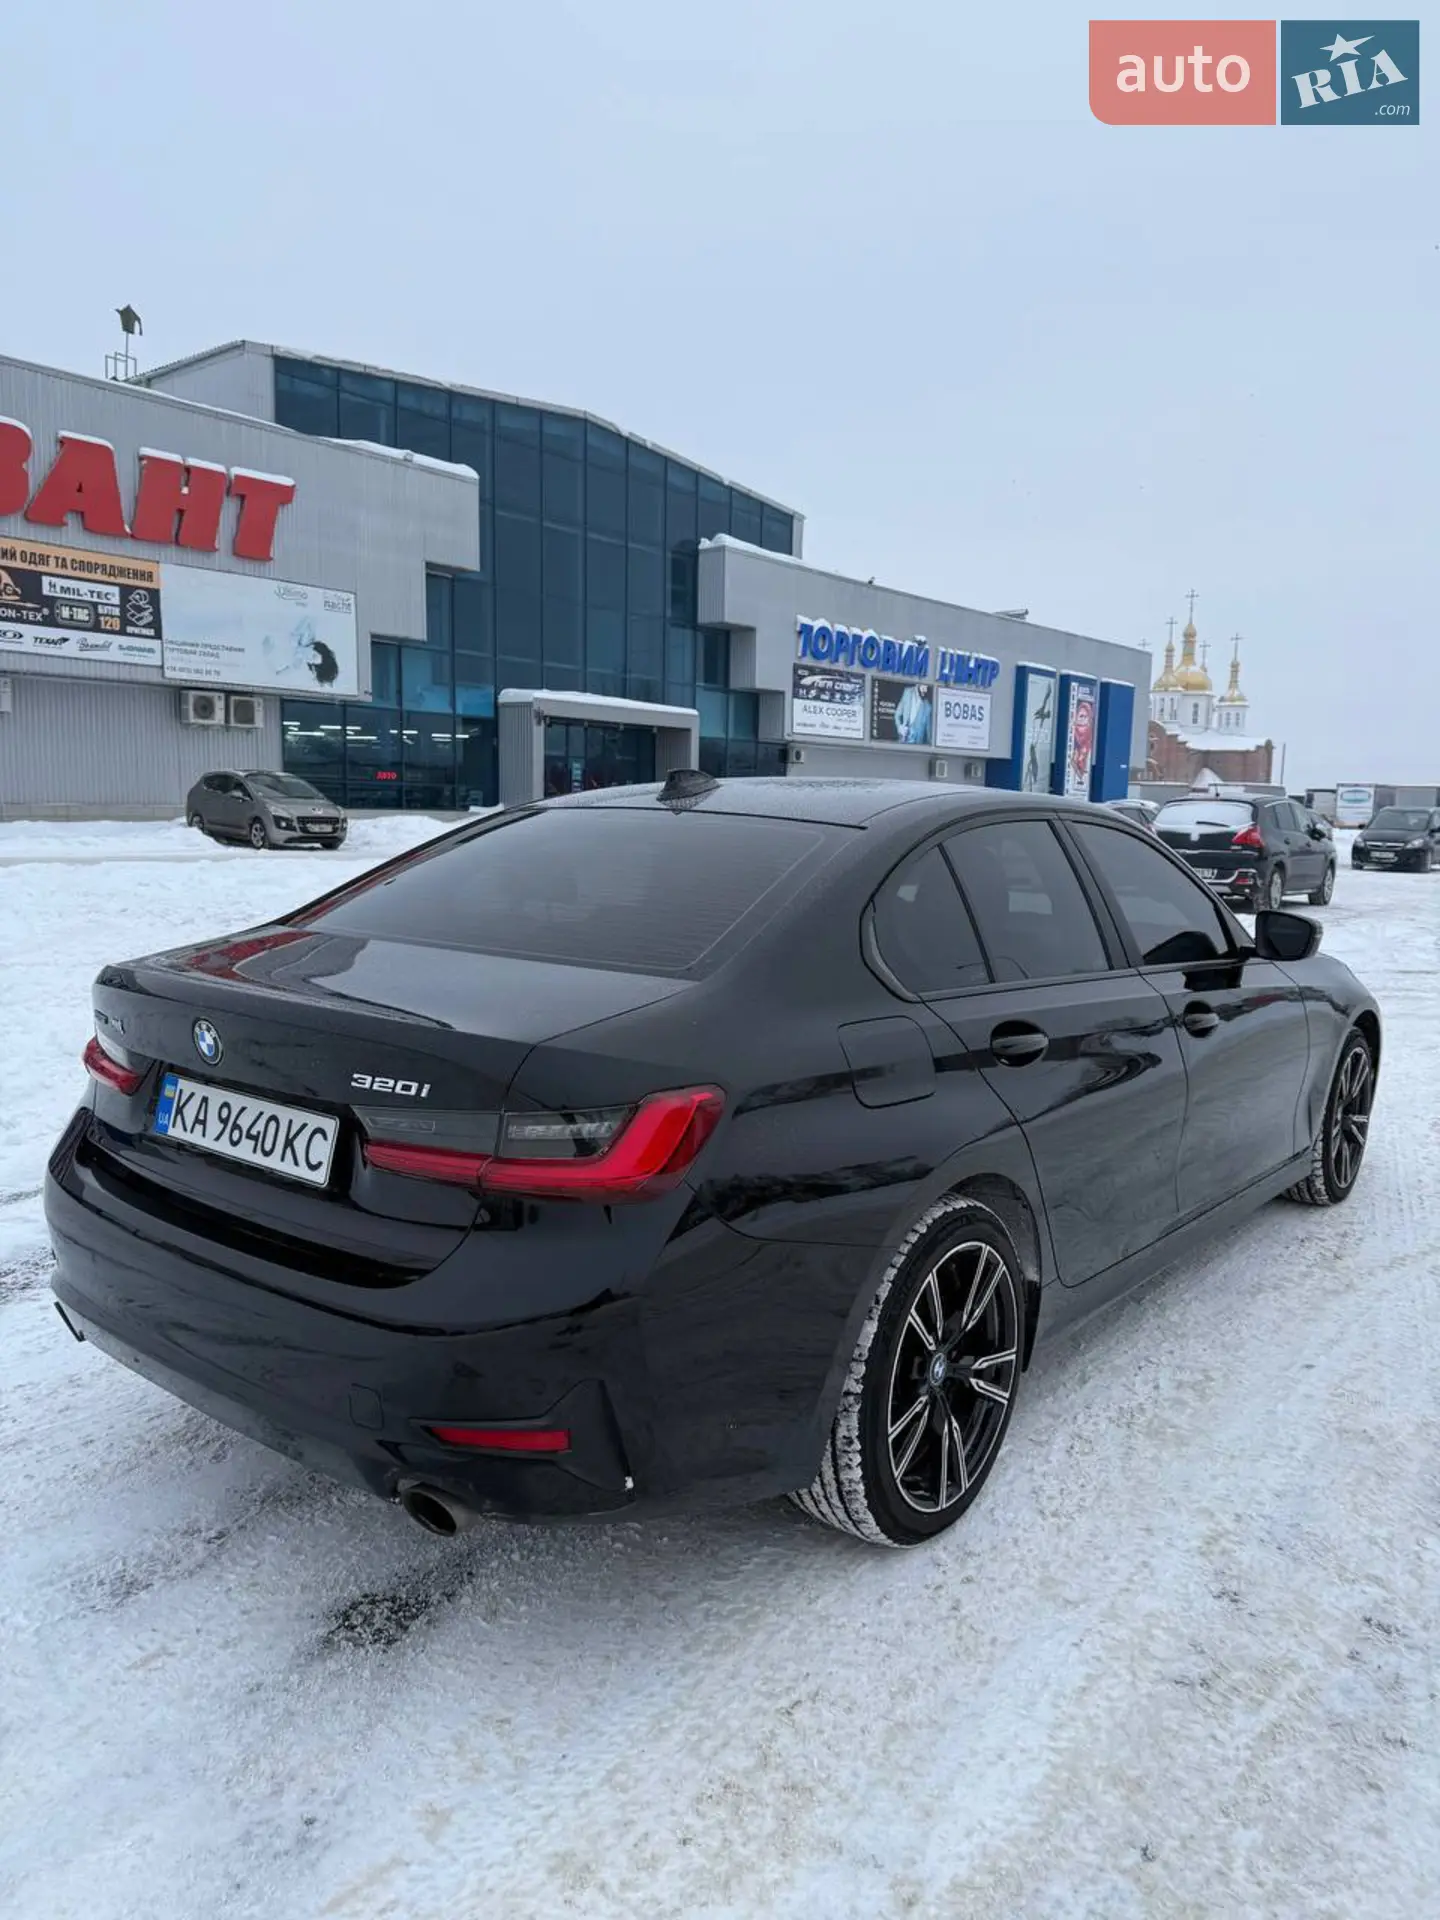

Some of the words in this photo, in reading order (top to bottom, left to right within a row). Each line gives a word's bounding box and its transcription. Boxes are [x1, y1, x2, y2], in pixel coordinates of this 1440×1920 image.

[20, 549, 50, 568] ОДЯГ
[54, 557, 68, 570] ТА
[71, 558, 154, 583] СПОРЯДЖЕННЯ
[797, 617, 930, 676] ТОРГОВИЙ
[943, 701, 985, 722] BOBAS
